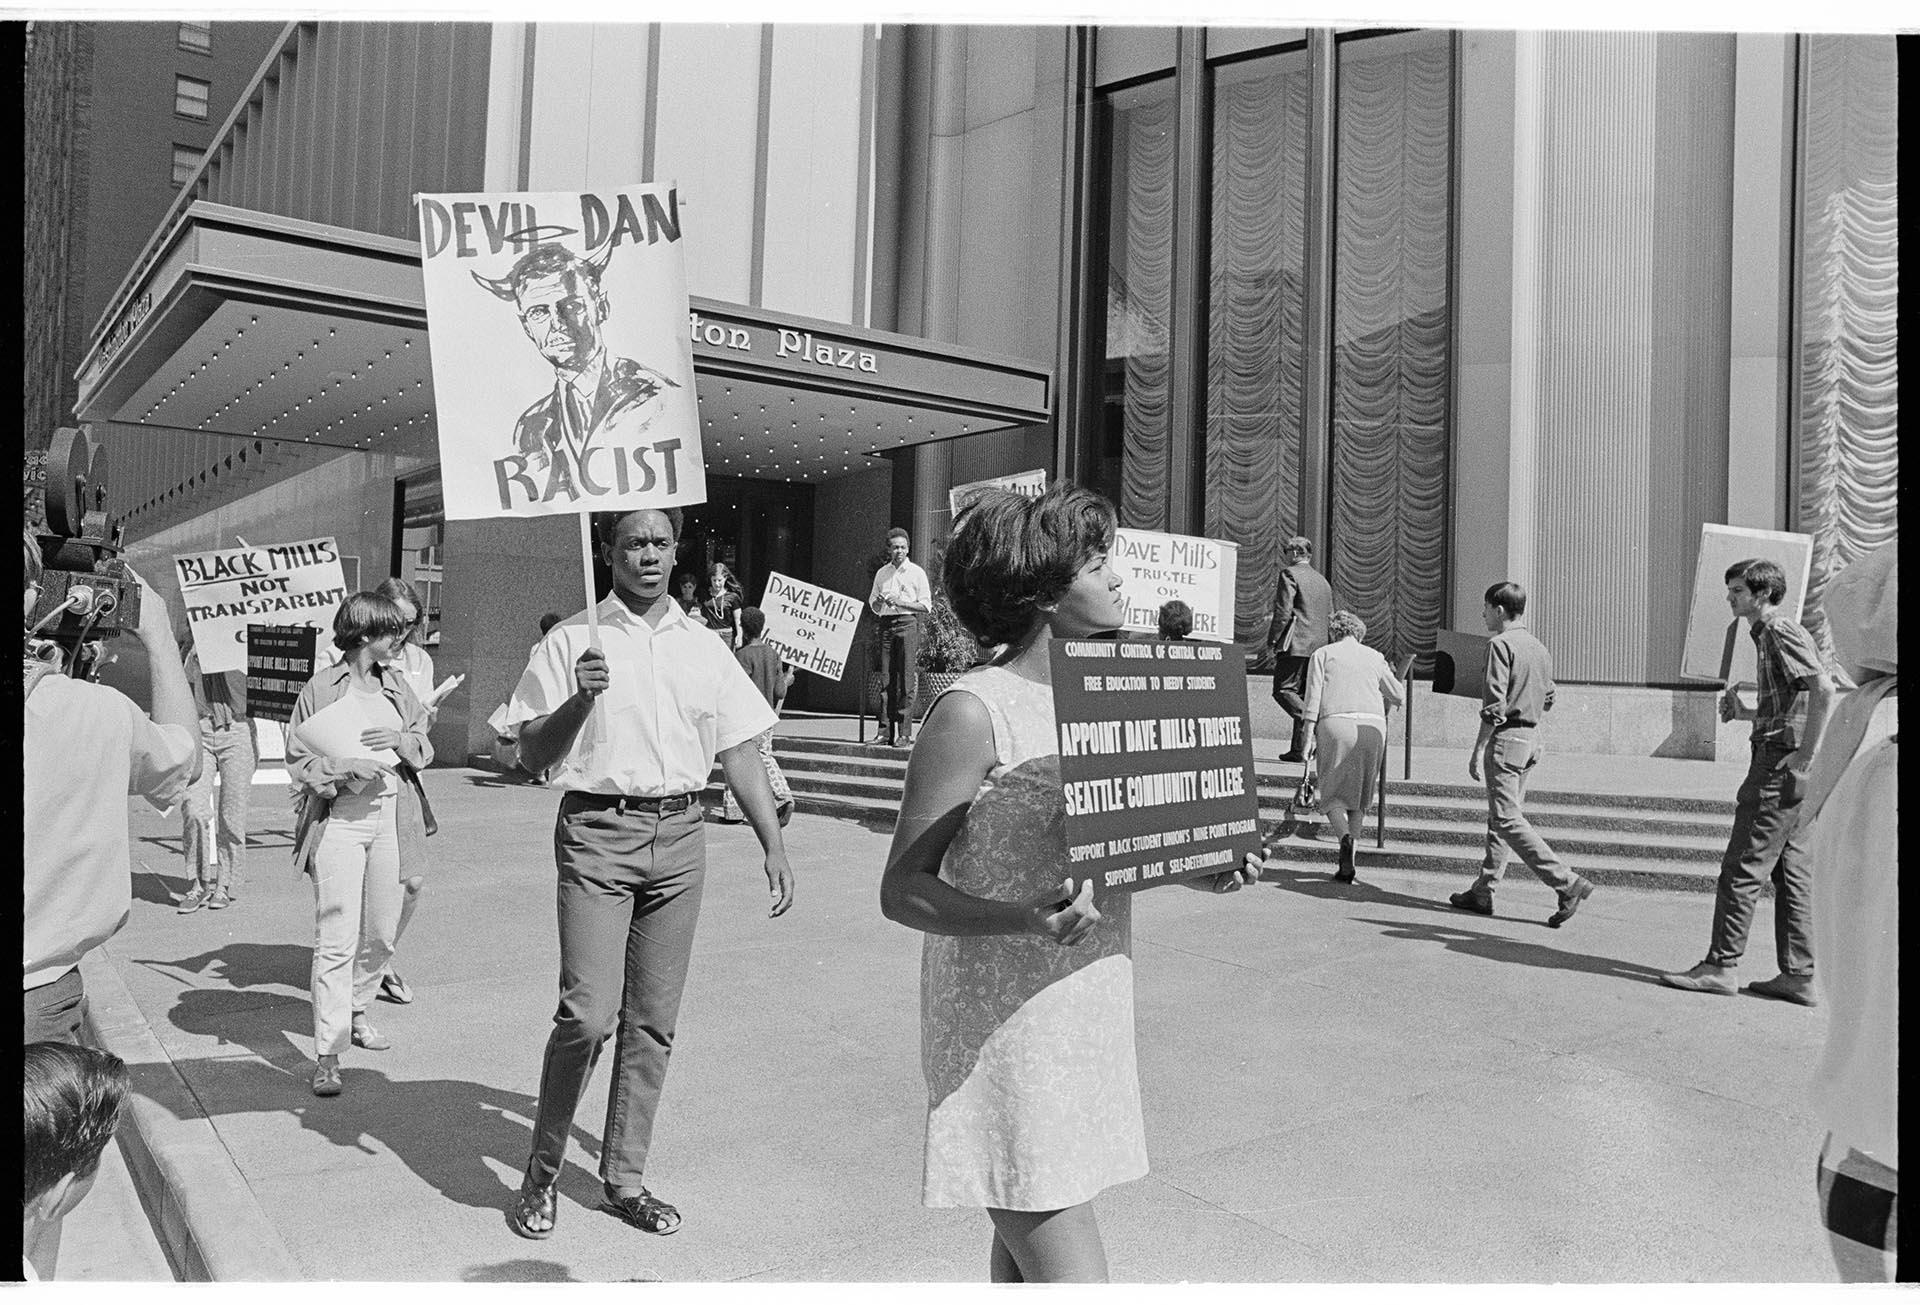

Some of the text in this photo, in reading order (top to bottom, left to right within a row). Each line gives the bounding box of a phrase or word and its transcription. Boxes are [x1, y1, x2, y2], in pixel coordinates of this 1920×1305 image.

[421, 188, 682, 259] DEVIL DAN
[776, 328, 877, 373] Plaza
[493, 438, 682, 510] RACIST
[177, 541, 337, 583] BLACK MILLS
[1115, 534, 1160, 563] DAVE
[240, 577, 290, 597] NOT
[769, 576, 812, 607] DAVE
[1132, 567, 1197, 585] TRUSTEE
[186, 587, 345, 622] TRANSPARENT
[1157, 586, 1179, 598] OR
[1123, 596, 1216, 632] IETN ERE
[796, 628, 816, 640] OR
[810, 647, 844, 678] HERE
[1065, 642, 1223, 660] COMMUNITY CONTROL OF CENTRAL CAMPUS
[1084, 676, 1215, 691] FREE EDUCATION TO NEEDY STUDENTS
[1061, 716, 1243, 756] APPOINT DAVE MILLS TRUSTEE
[1064, 766, 1245, 816] SEATTLE COMMUNITY COLLEGE
[1070, 819, 1256, 862] SUPPORT BLACK STUDENT UNION'S NINE POINT PROGRAM
[1105, 866, 1137, 886] SUPPORT
[1142, 861, 1164, 879] BLACK
